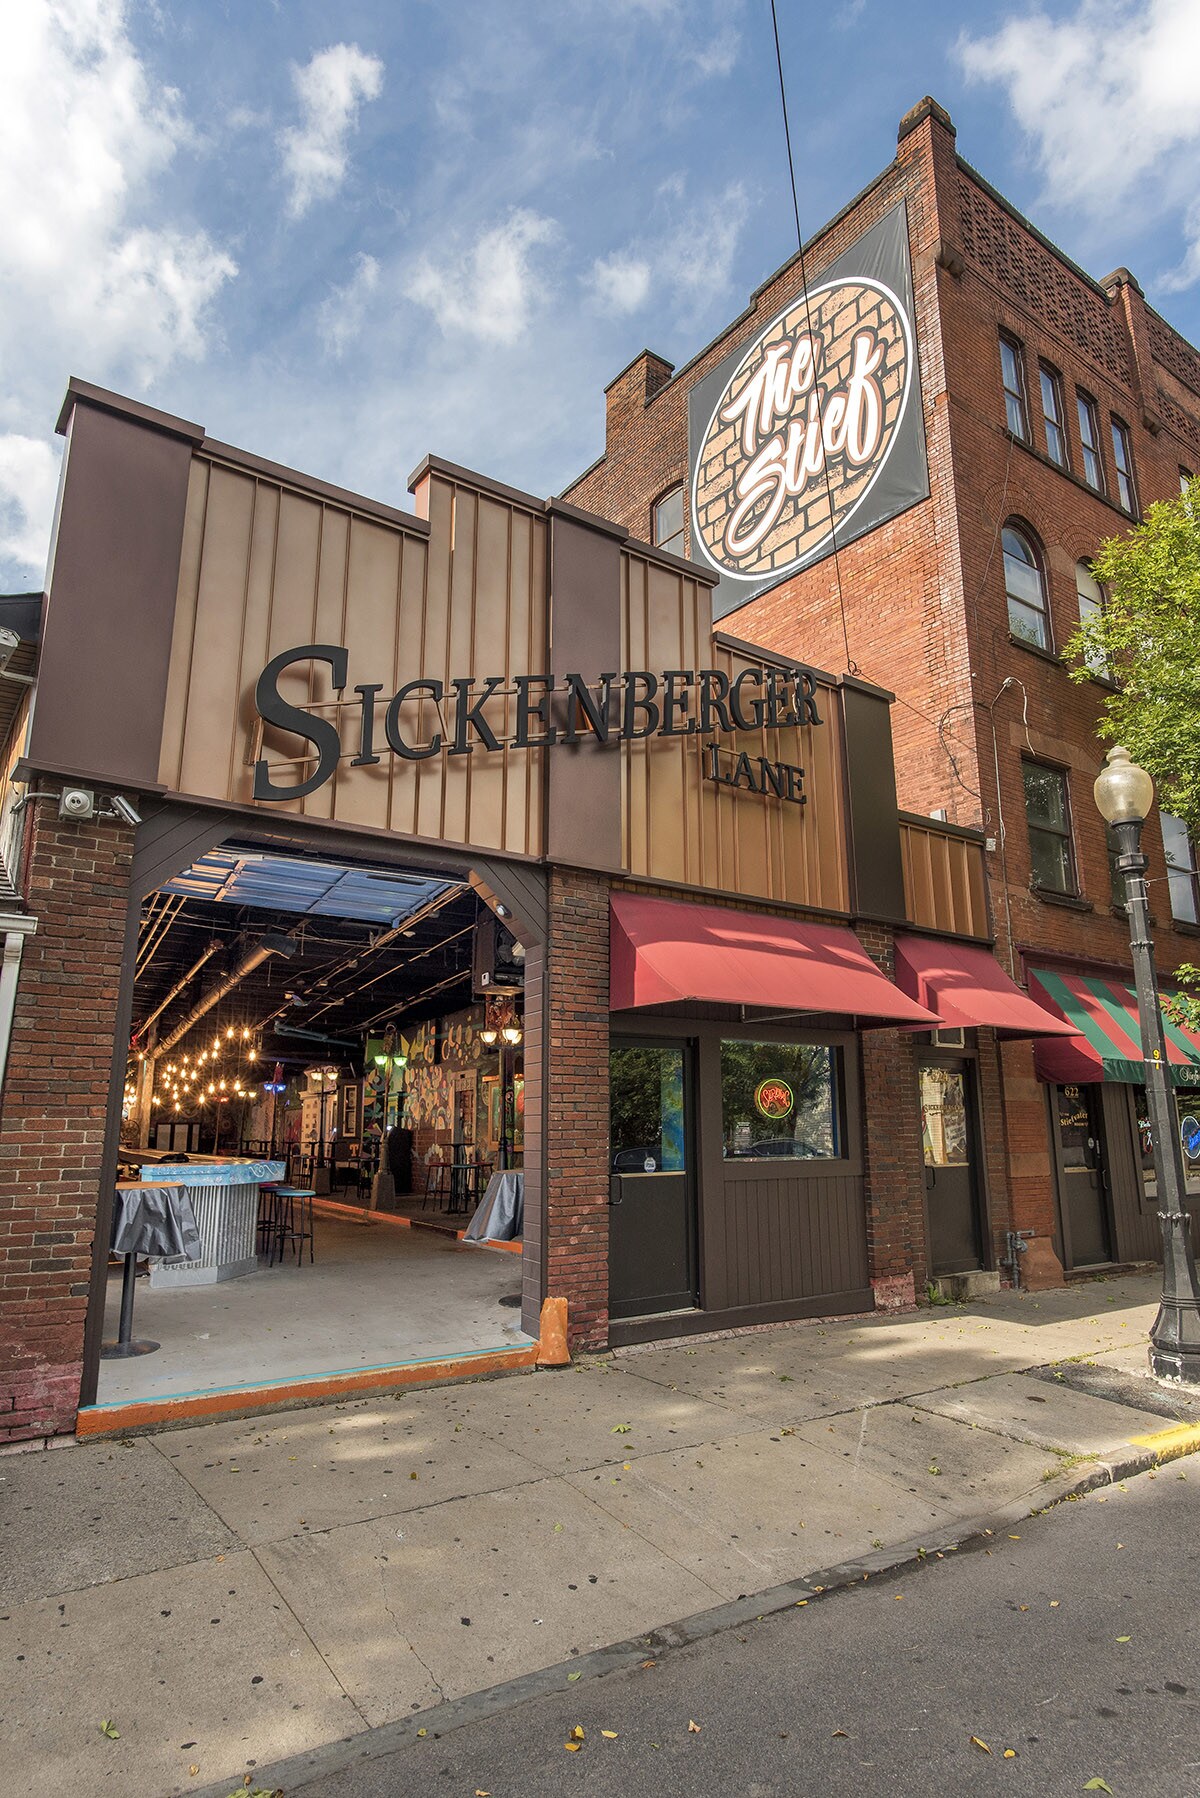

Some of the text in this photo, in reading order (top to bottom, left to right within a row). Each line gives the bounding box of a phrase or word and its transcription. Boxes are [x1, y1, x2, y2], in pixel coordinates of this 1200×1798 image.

[721, 334, 821, 455] The
[727, 332, 884, 555] Stief
[252, 644, 823, 802] SICKENBERGER
[704, 743, 807, 805] LANE
[1064, 1087, 1079, 1097] 622
[1152, 1049, 1160, 1060] 9
